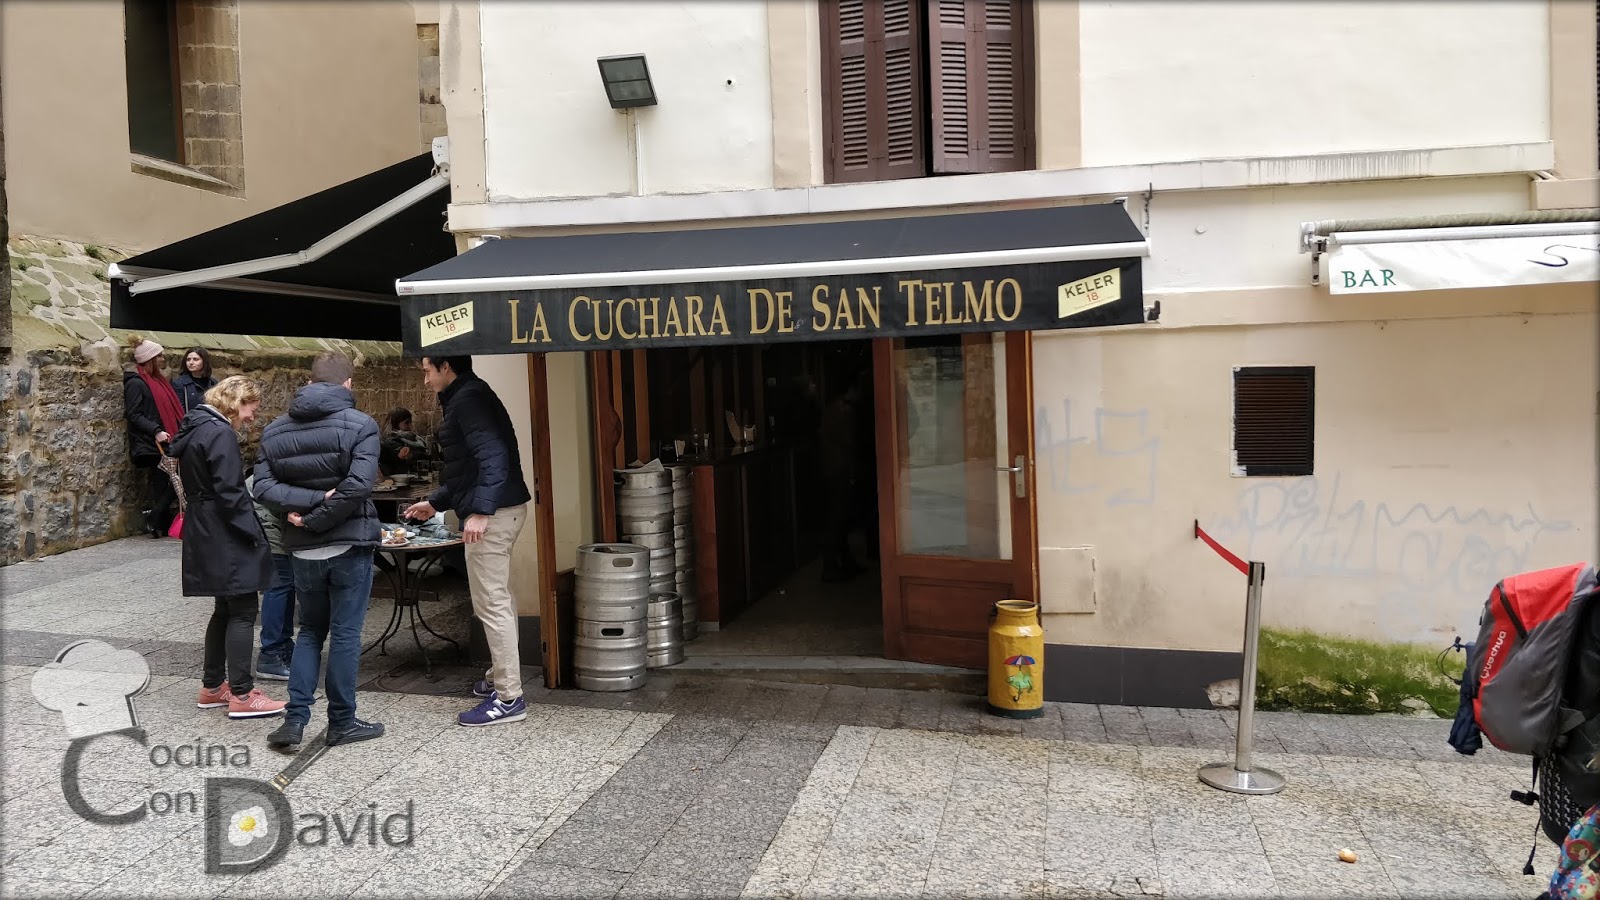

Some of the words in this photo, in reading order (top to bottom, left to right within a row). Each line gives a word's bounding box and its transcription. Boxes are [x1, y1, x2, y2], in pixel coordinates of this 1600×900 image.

[1064, 274, 1114, 299] KELER
[1341, 269, 1397, 289] BAR
[1086, 291, 1099, 303] 18
[426, 307, 469, 329] KELER
[508, 299, 552, 344] LA
[568, 294, 731, 342] CUCHARA
[747, 287, 795, 335] DE
[811, 284, 882, 332] SAN
[899, 277, 1023, 326] TELMO
[445, 323, 456, 333] 18
[1480, 630, 1507, 680] Quechua
